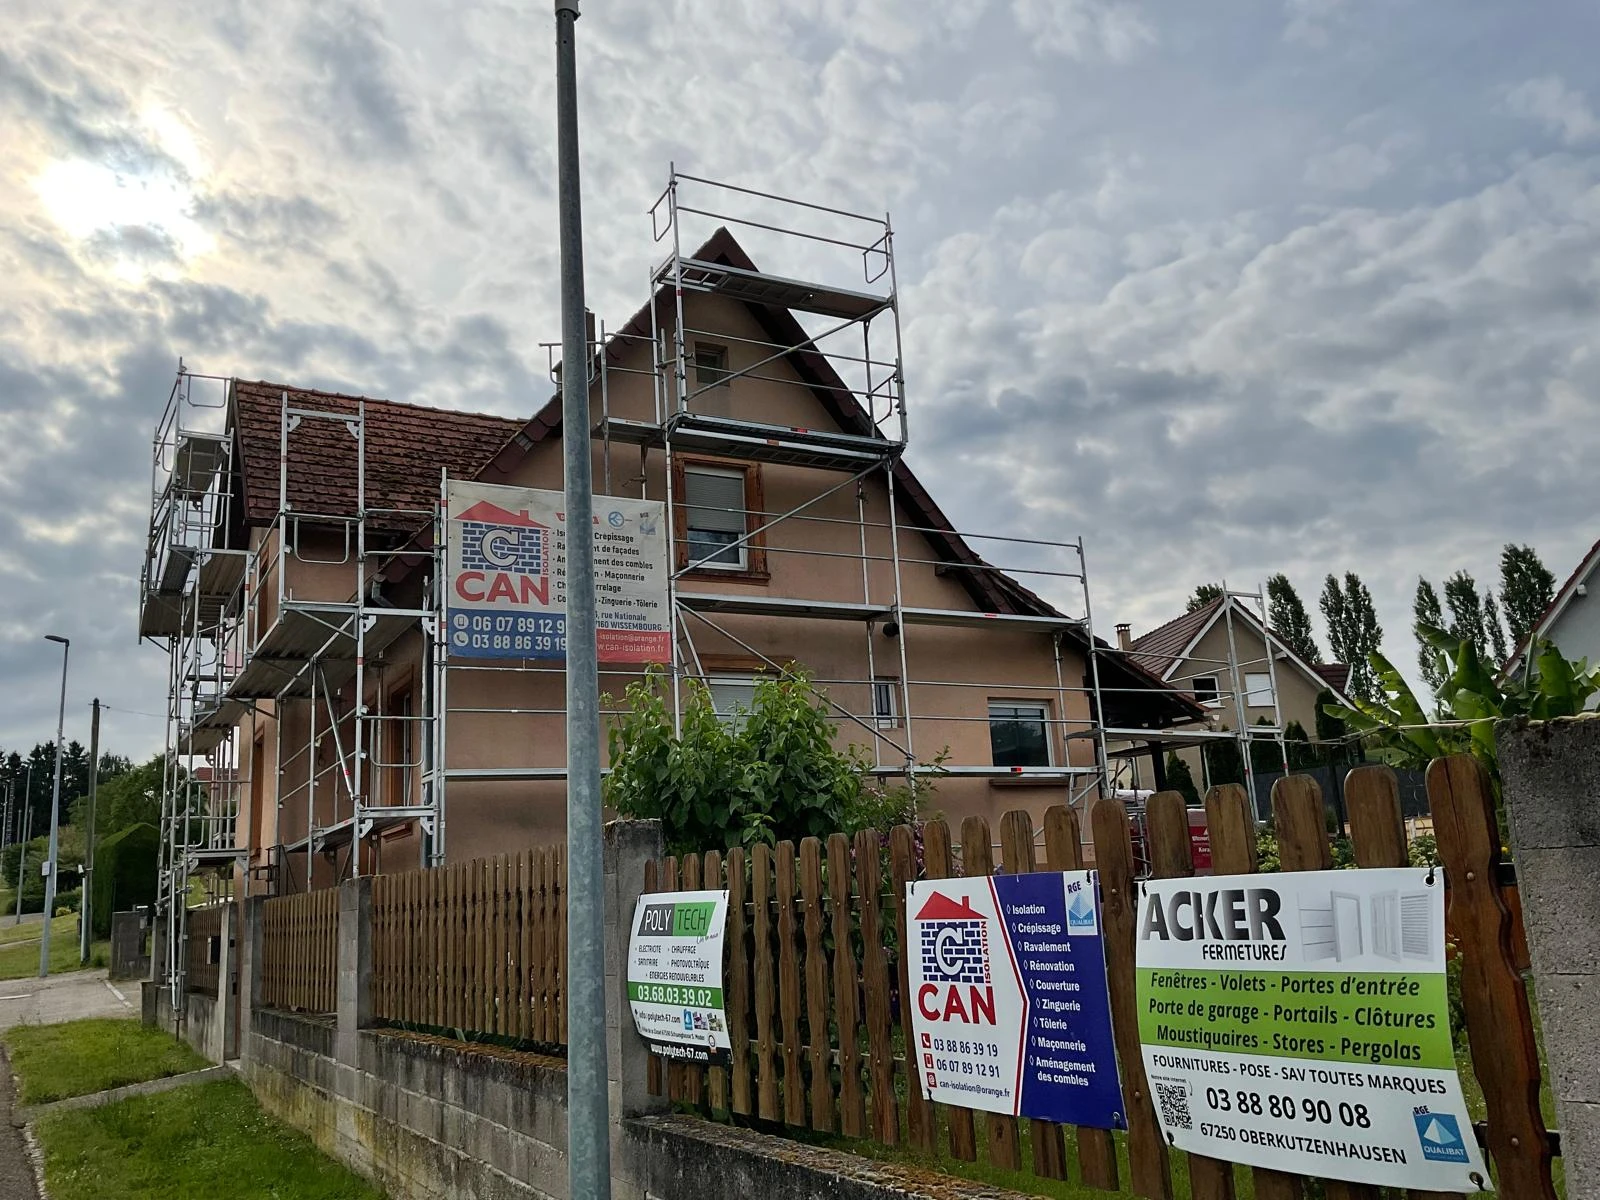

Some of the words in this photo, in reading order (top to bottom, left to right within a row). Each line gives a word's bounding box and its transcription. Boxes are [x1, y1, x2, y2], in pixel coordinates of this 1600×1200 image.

[594, 531, 634, 543] Crépissage
[542, 529, 550, 575] ISOLATION
[602, 545, 611, 553] de
[612, 545, 640, 556] façades
[611, 559, 624, 567] des
[625, 560, 653, 570] combles
[605, 570, 645, 582] Maçonnerie
[455, 571, 550, 606] CAN
[596, 583, 622, 594] rrelage
[601, 596, 632, 607] Zinguerie
[636, 598, 658, 609] Tôlerie
[472, 615, 492, 631] 06
[496, 616, 514, 632] 07
[517, 617, 535, 633] 89
[538, 619, 553, 634] 12
[556, 620, 565, 634] 9
[614, 611, 647, 622] Nationale
[610, 621, 663, 632] WISSEMBOURG
[472, 634, 489, 648] 03
[493, 635, 511, 649] 88
[514, 635, 532, 650] 86
[535, 636, 552, 650] 39
[554, 637, 566, 651] 19
[597, 633, 664, 644] -isolation@orange.fr
[1067, 880, 1082, 895] RGE
[1012, 904, 1046, 915] Isolation
[1141, 888, 1286, 941] ACKER
[644, 909, 672, 931] POLY
[677, 908, 708, 931] TECH
[1018, 922, 1061, 935] Crépissage
[671, 945, 697, 955] CHAUFFAGE
[980, 920, 991, 984] ISOLATION
[1023, 941, 1071, 952] Ravalement
[1202, 944, 1287, 961] FERMETURES
[637, 958, 658, 967] SANITAIRE
[1029, 960, 1075, 972] Rénovation
[669, 972, 705, 983] RENOUVELABLES
[1035, 979, 1080, 991] Couverture
[1151, 971, 1207, 989] Fenêtres
[1220, 974, 1266, 992] Volets
[1281, 975, 1335, 994] Portes
[1340, 975, 1420, 996] d'entrée
[637, 984, 713, 1007] 03.68.03.39.02
[918, 983, 997, 1026] CAN
[1041, 998, 1081, 1013] Zinguerie
[1149, 998, 1184, 1015] Porte
[1188, 1000, 1204, 1016] de
[1208, 1004, 1259, 1024] garage
[1273, 1004, 1338, 1024] Portails
[1355, 1007, 1436, 1029] Clôtures
[1039, 1017, 1068, 1030] Tôlerie
[650, 1043, 709, 1060] www.polytech-67.com
[934, 1038, 944, 1051] 03
[946, 1039, 958, 1053] 88
[959, 1041, 971, 1054] 86
[972, 1042, 984, 1056] 39
[986, 1043, 998, 1057] 19
[1037, 1036, 1087, 1052] Maçonnerie
[1157, 1025, 1259, 1049] Moustiquaires
[1272, 1032, 1325, 1054] Stores
[1341, 1037, 1422, 1063] Pergolas
[936, 1058, 947, 1071] 06
[949, 1060, 959, 1073] 07
[962, 1061, 973, 1075] 89
[975, 1063, 987, 1077] 12
[988, 1065, 1000, 1078] 91
[1036, 1056, 1096, 1073] Aménagement
[1037, 1070, 1052, 1082] des
[1053, 1073, 1089, 1087] combles
[1152, 1054, 1231, 1075] FOURNITURES
[1239, 1063, 1272, 1079] POSE
[1281, 1066, 1306, 1082] SAV
[1308, 1069, 1364, 1088] TOUTES
[1367, 1074, 1447, 1096] MARQUES
[939, 1080, 1010, 1098] can-isolation@orange.fr
[1206, 1087, 1232, 1112] 03
[1236, 1091, 1264, 1116] 88
[1268, 1094, 1297, 1120] 80
[1301, 1098, 1332, 1125] 90
[1338, 1102, 1371, 1129] 08
[1412, 1104, 1430, 1116] RGE
[1200, 1122, 1236, 1141] 67250
[1239, 1128, 1407, 1165] OBERKUTZENHAUSEN
[1423, 1145, 1464, 1157] QUALIBAT
